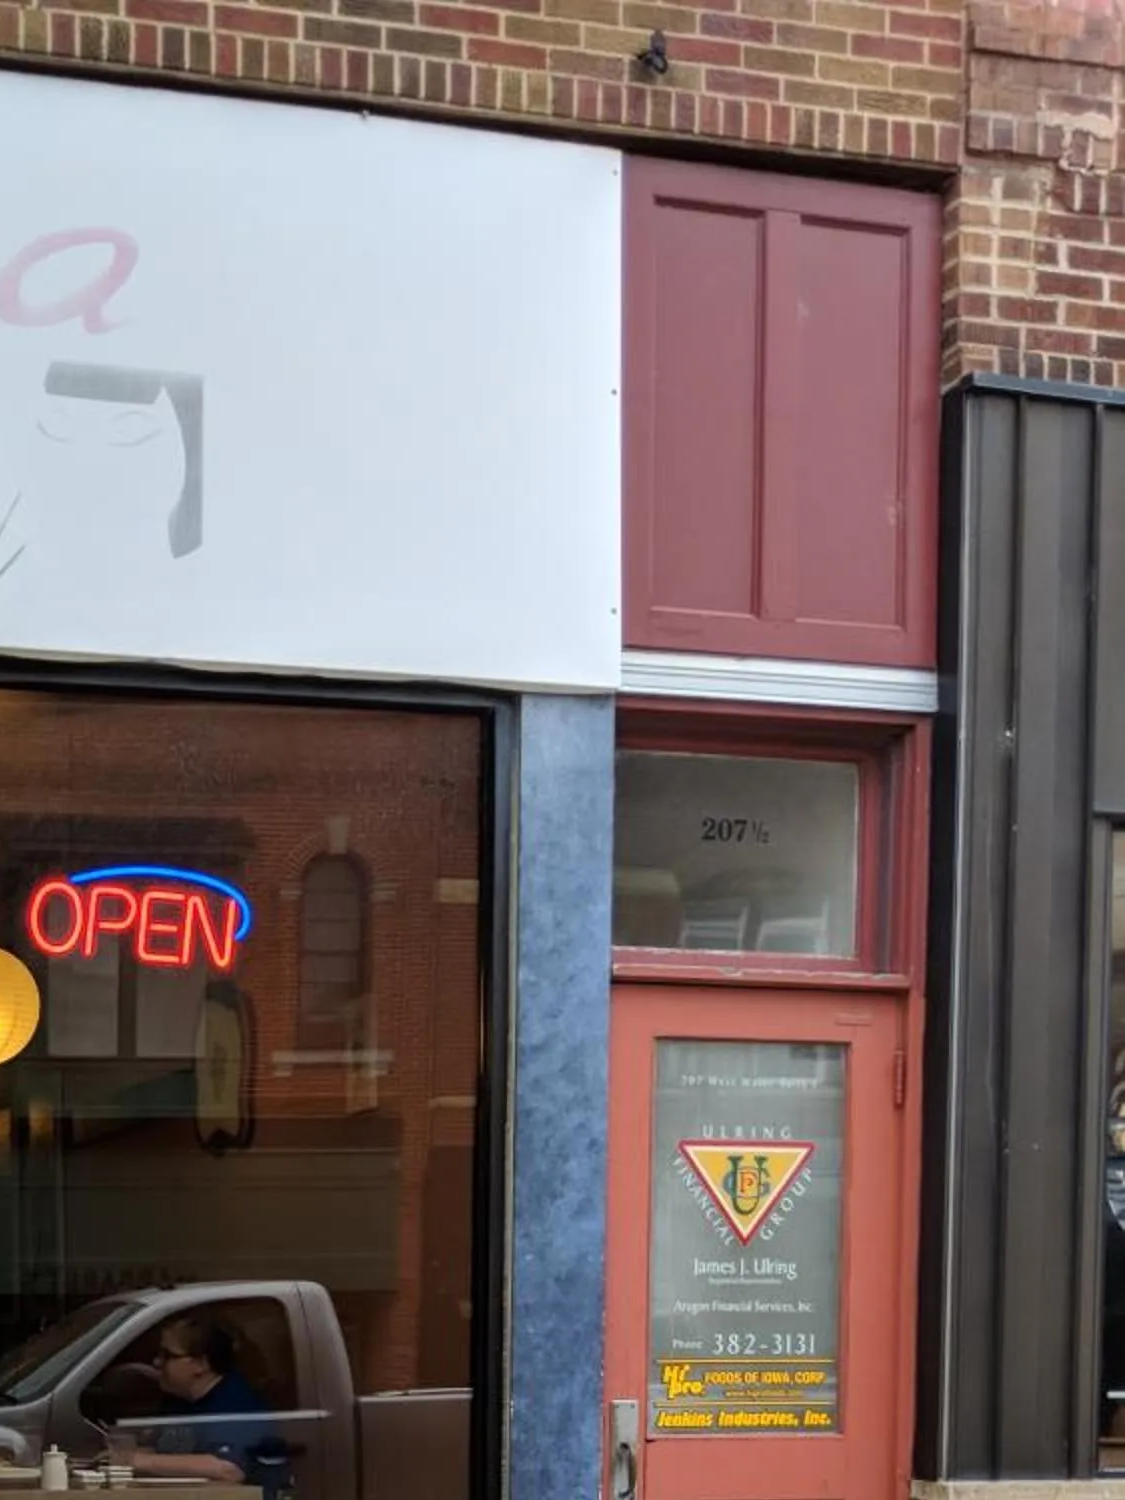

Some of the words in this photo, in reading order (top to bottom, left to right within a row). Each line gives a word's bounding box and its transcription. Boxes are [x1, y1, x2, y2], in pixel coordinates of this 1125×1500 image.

[701, 817, 748, 842] 207
[29, 880, 237, 968] OPEN
[702, 1124, 792, 1139] ULRING
[672, 1157, 734, 1246] FINANCIAL
[760, 1167, 812, 1241] GROUP
[693, 1257, 736, 1276] James
[754, 1257, 798, 1281] Ulring
[712, 1333, 815, 1355] 382-3131
[744, 1371, 759, 1384] OF
[657, 1410, 713, 1427] Jenkins
[804, 1410, 832, 1425] Inc.
